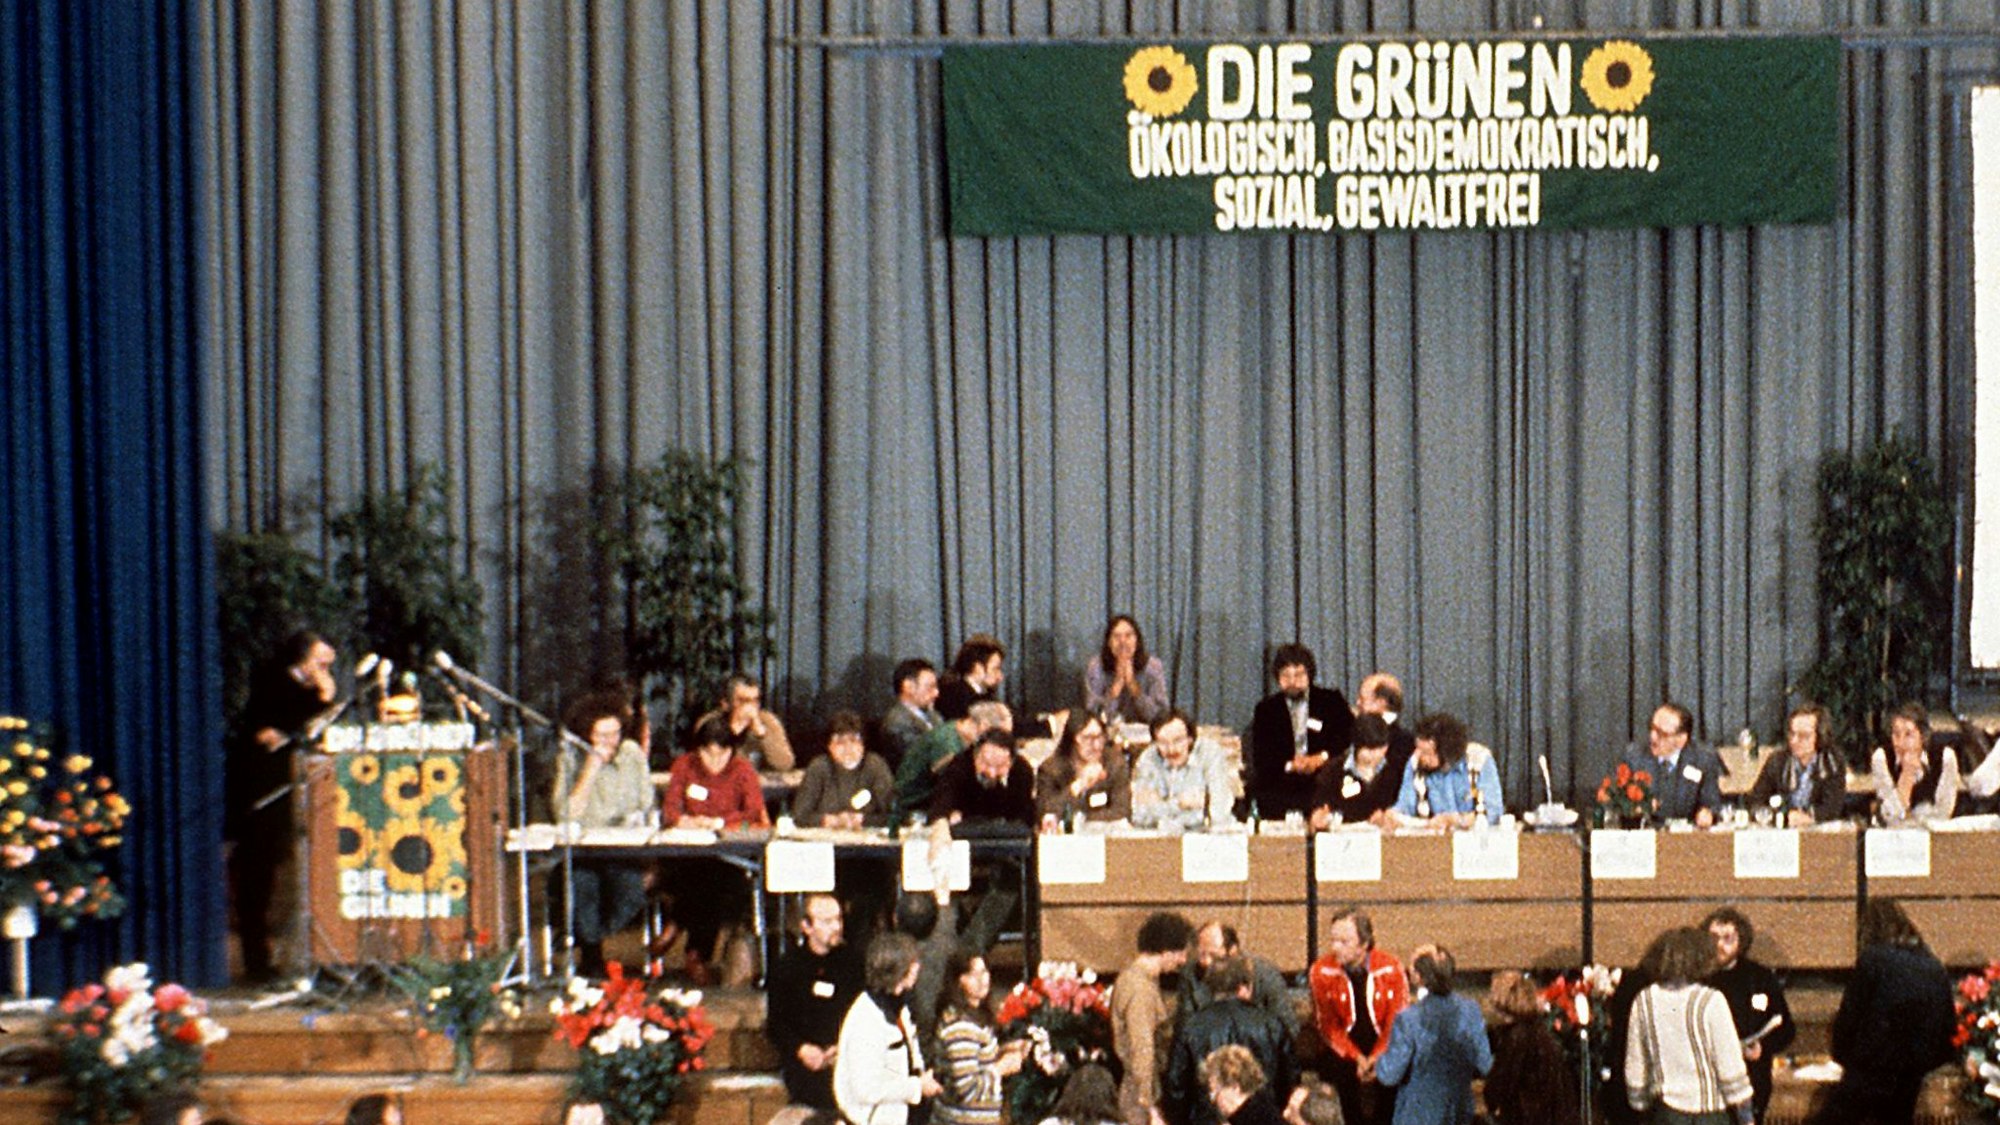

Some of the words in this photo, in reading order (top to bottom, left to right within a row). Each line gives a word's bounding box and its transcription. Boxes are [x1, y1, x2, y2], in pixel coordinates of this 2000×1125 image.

[1207, 43, 1314, 121] DIE
[1336, 41, 1573, 120] GRÜNEN
[1127, 109, 1326, 178] ÖKOLOGISCH,
[1328, 115, 1660, 173] BASISDEMOKRATISCH,
[1214, 174, 1334, 232] SOZIAL,
[1336, 172, 1540, 230] GEWALTFREI
